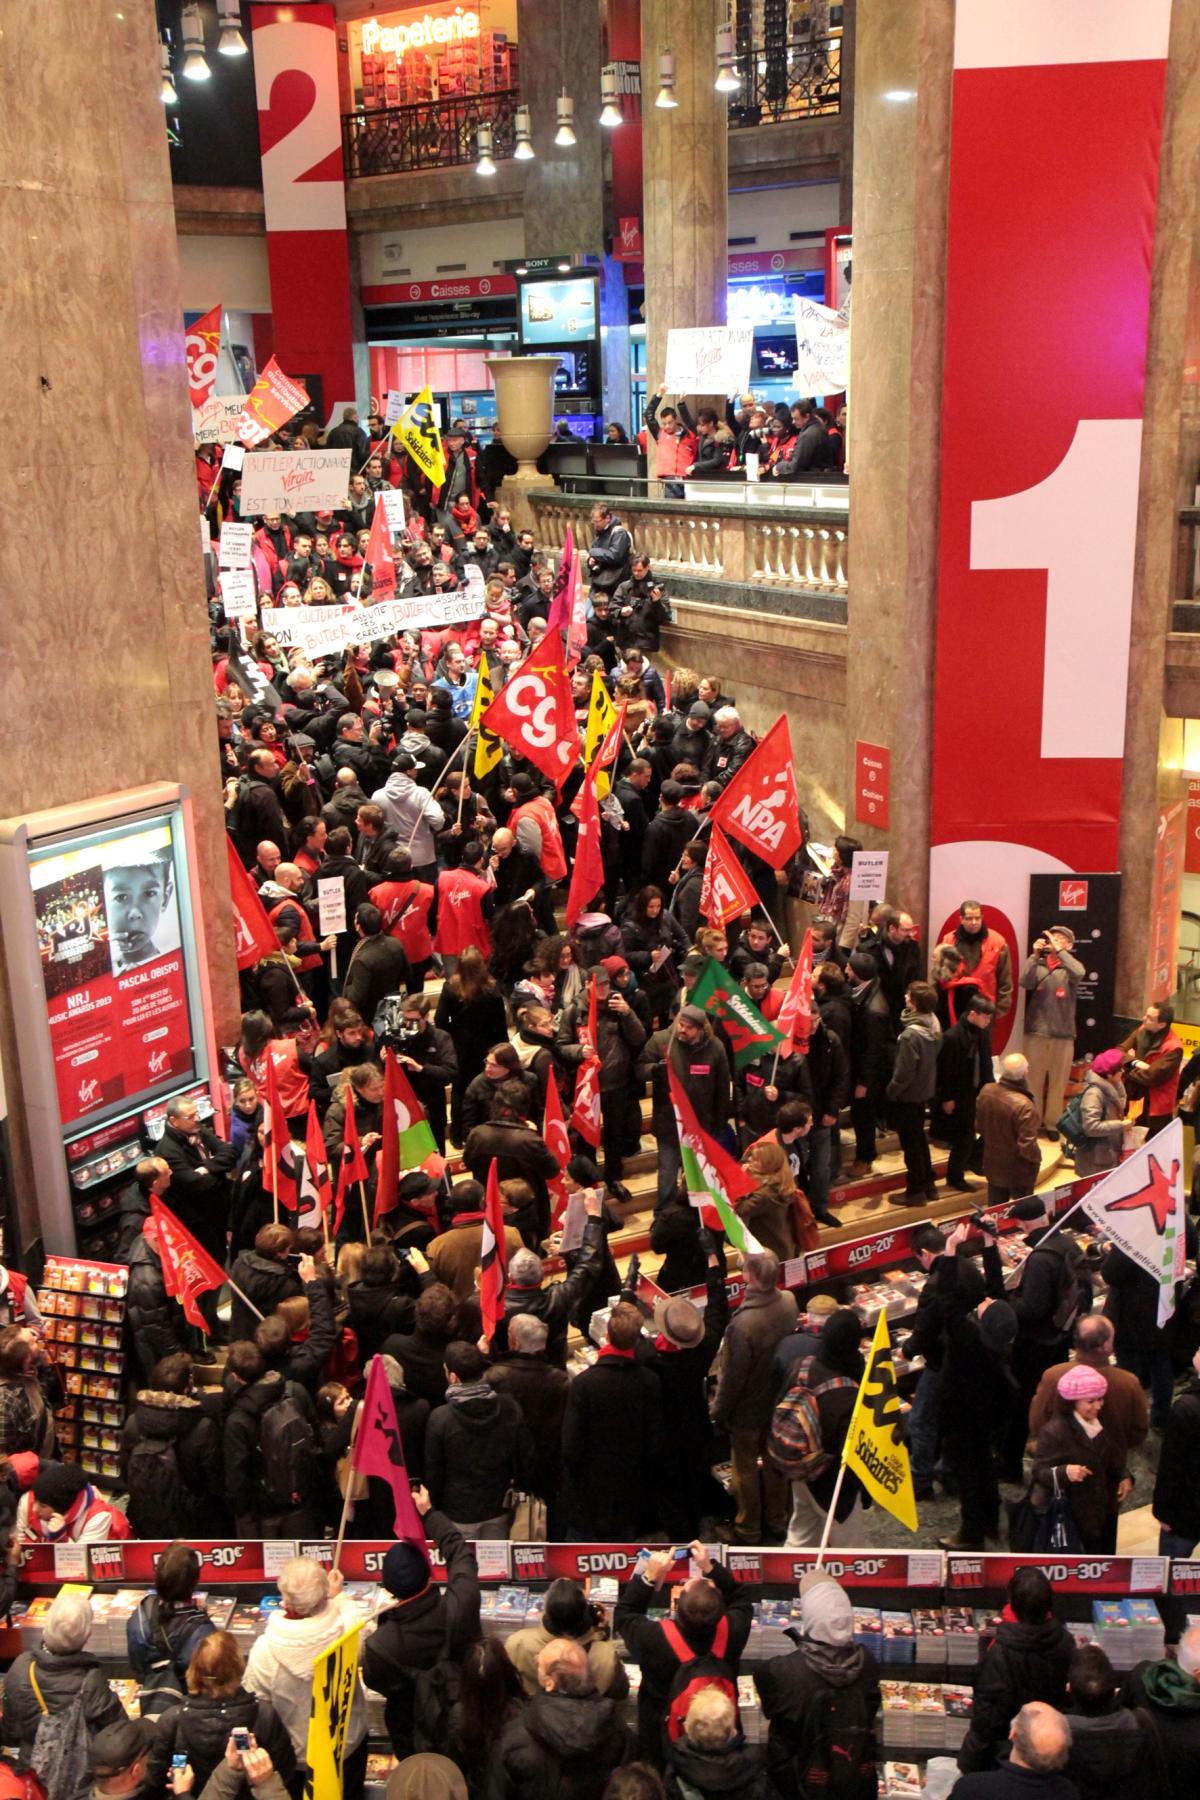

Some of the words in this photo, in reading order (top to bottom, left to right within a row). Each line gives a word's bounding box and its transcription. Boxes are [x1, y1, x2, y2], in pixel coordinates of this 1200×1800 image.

[361, 6, 480, 57] Papeterie
[525, 259, 549, 268] SONY
[431, 284, 470, 297] Caisses
[247, 457, 292, 472] BUTLER
[281, 470, 315, 490] Virgin
[247, 498, 267, 511] EST
[274, 497, 293, 511] TON
[969, 419, 1143, 758] 1
[392, 602, 441, 623] BUTLER
[305, 624, 351, 650] BUTLER
[731, 793, 788, 850] NPA
[448, 883, 471, 906] Virgin
[1061, 884, 1085, 904] Virgin
[118, 972, 149, 991] PASCAL
[150, 961, 179, 980] OBISPO
[66, 990, 90, 1010] NRJ
[96, 996, 112, 1008] 2013
[727, 994, 768, 1035] Solidaires
[848, 1234, 896, 1264] 4CD=20€
[855, 1430, 904, 1495] Solidaires
[92, 1552, 121, 1564] CHOIX
[515, 1554, 544, 1564] CHOIX
[730, 1560, 760, 1570] CHOIX
[952, 1565, 982, 1574] CHOIX
